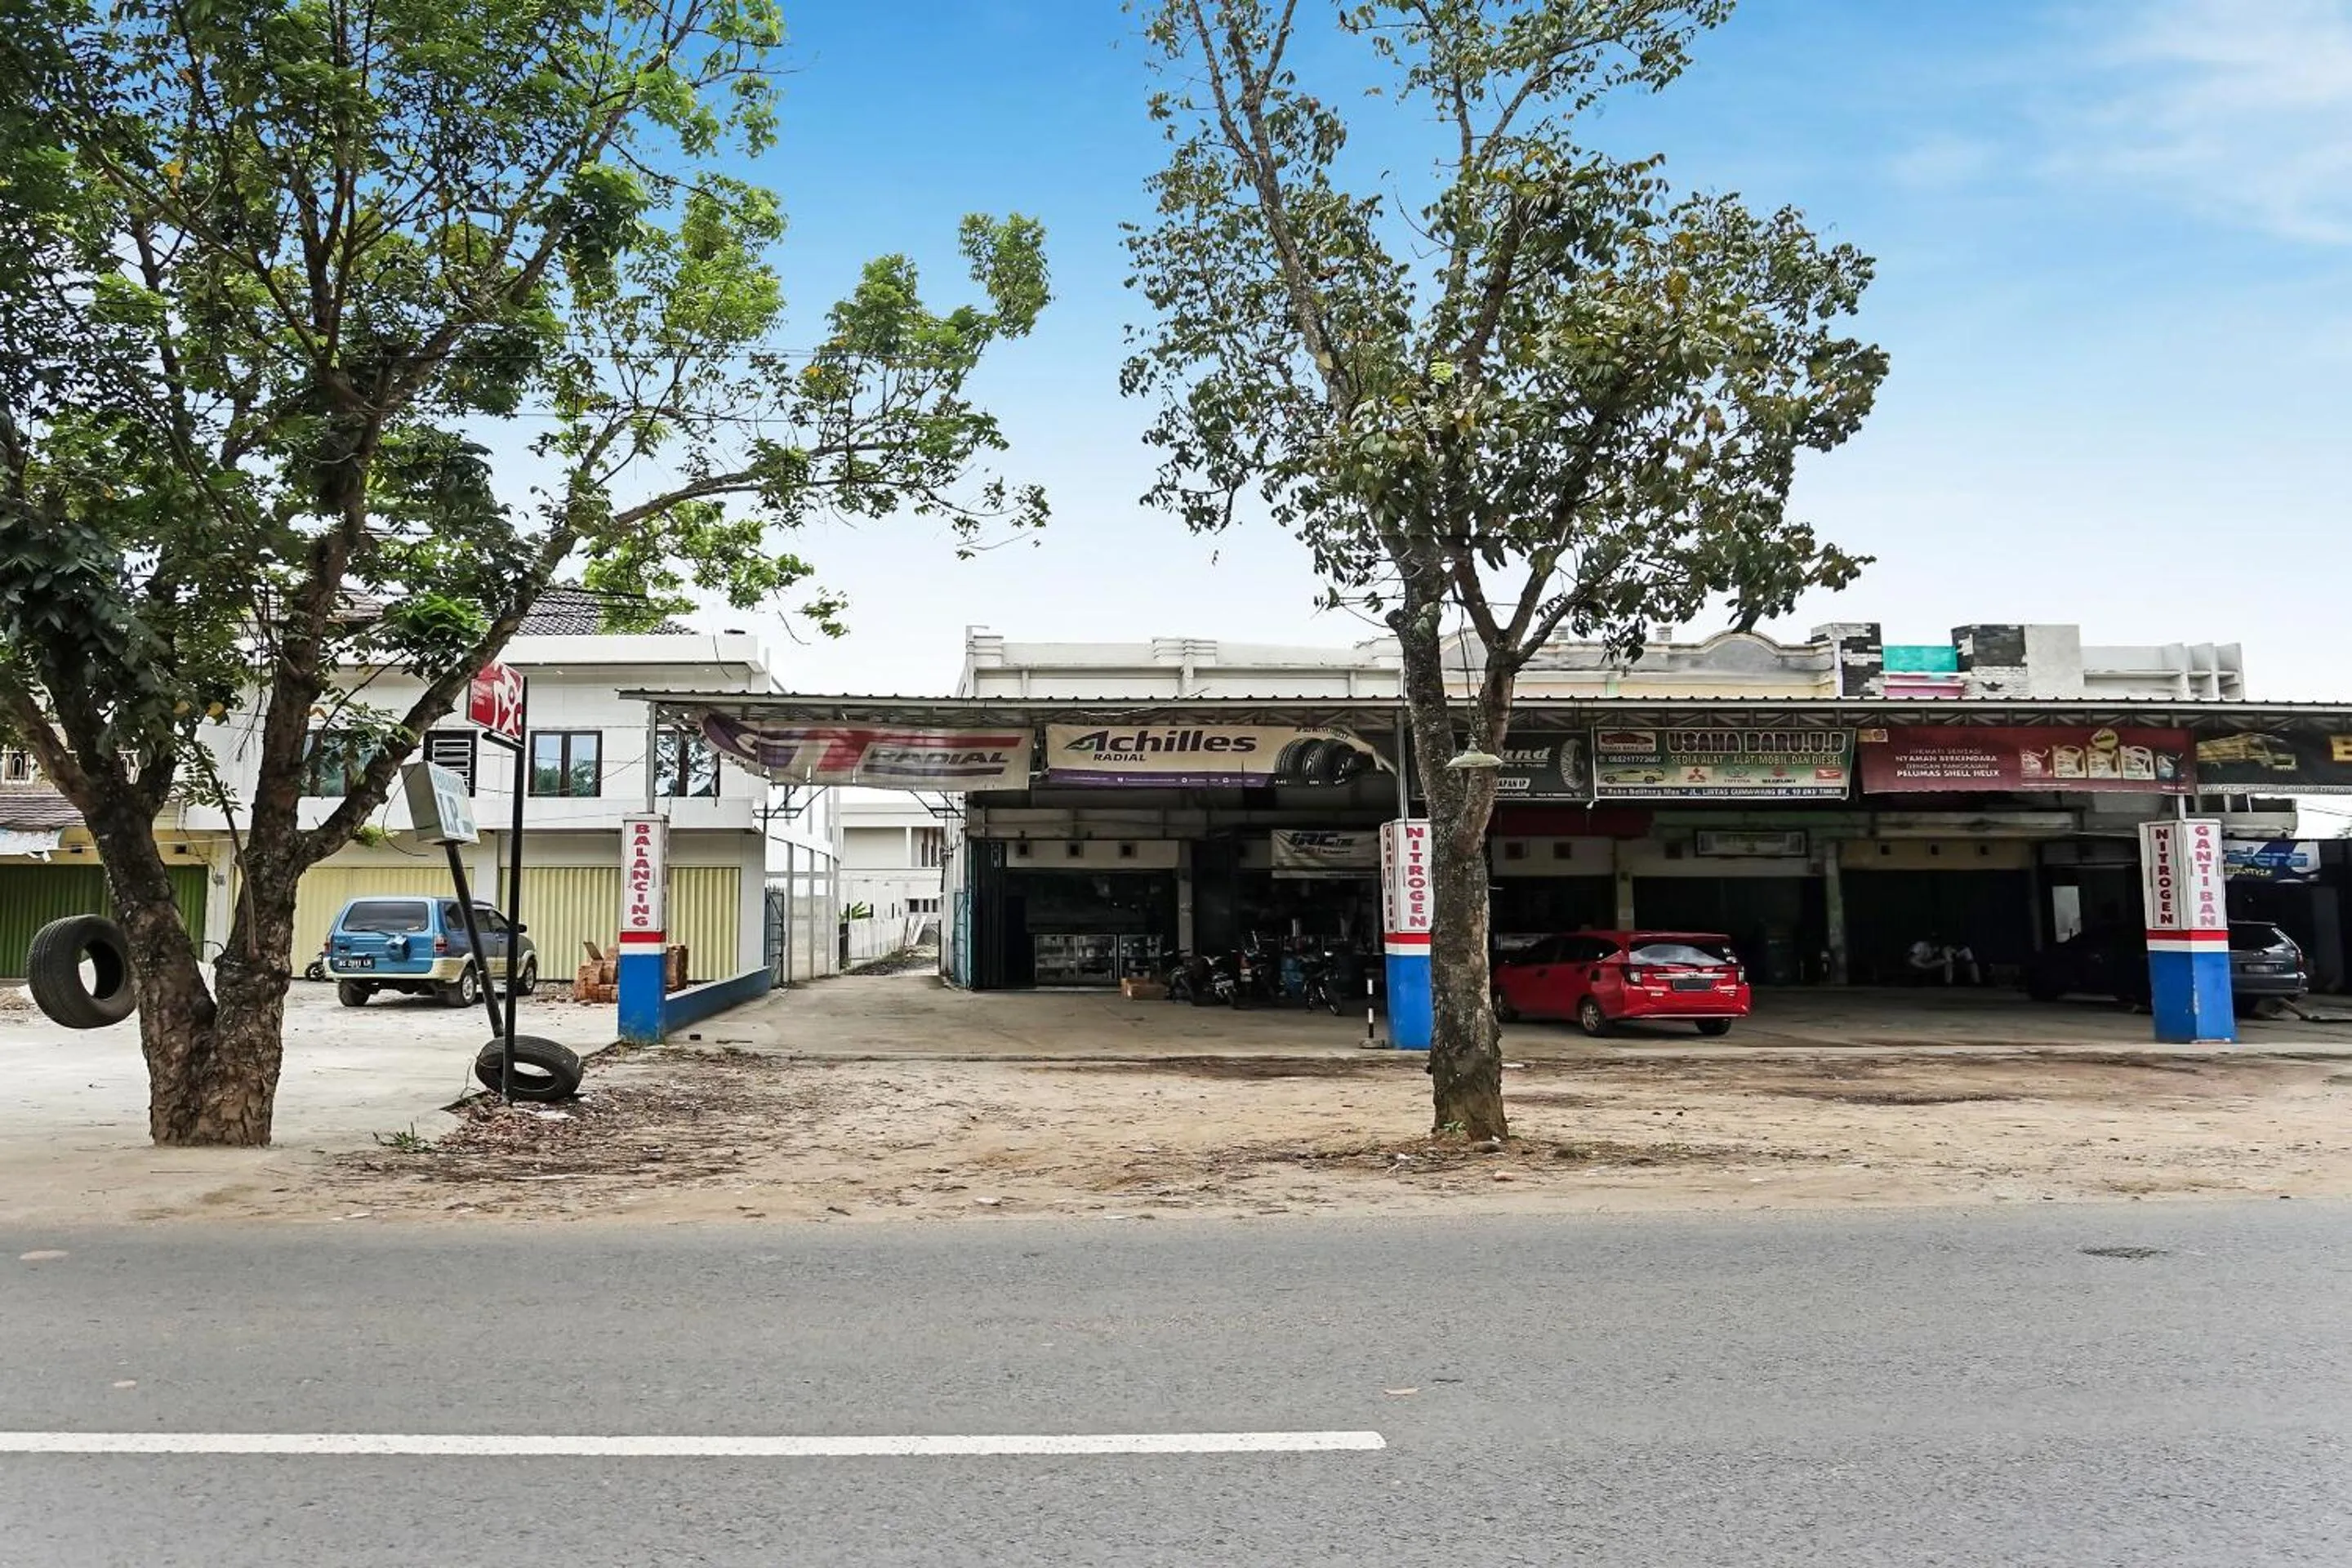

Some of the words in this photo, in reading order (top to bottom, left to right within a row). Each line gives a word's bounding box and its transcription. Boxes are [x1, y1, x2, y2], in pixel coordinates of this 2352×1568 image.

[869, 740, 1009, 764] RADIAL
[1064, 729, 1256, 752] Achilles
[1667, 732, 1741, 753] USAHA
[1094, 754, 1147, 762] RADIAL
[1671, 755, 1697, 764] SEDIA
[1701, 755, 1724, 764] ALAT
[1733, 755, 1755, 764] ALAT
[1759, 755, 1787, 764] MOBIL
[1792, 755, 1809, 764] DAN
[1812, 755, 1842, 765] DIESEL
[2194, 826, 2212, 887] GANTI
[631, 823, 652, 927] BALANCING
[1406, 827, 1427, 928] NITROGEN
[2155, 829, 2174, 924] NITROGEN
[2199, 891, 2216, 927] BAN
